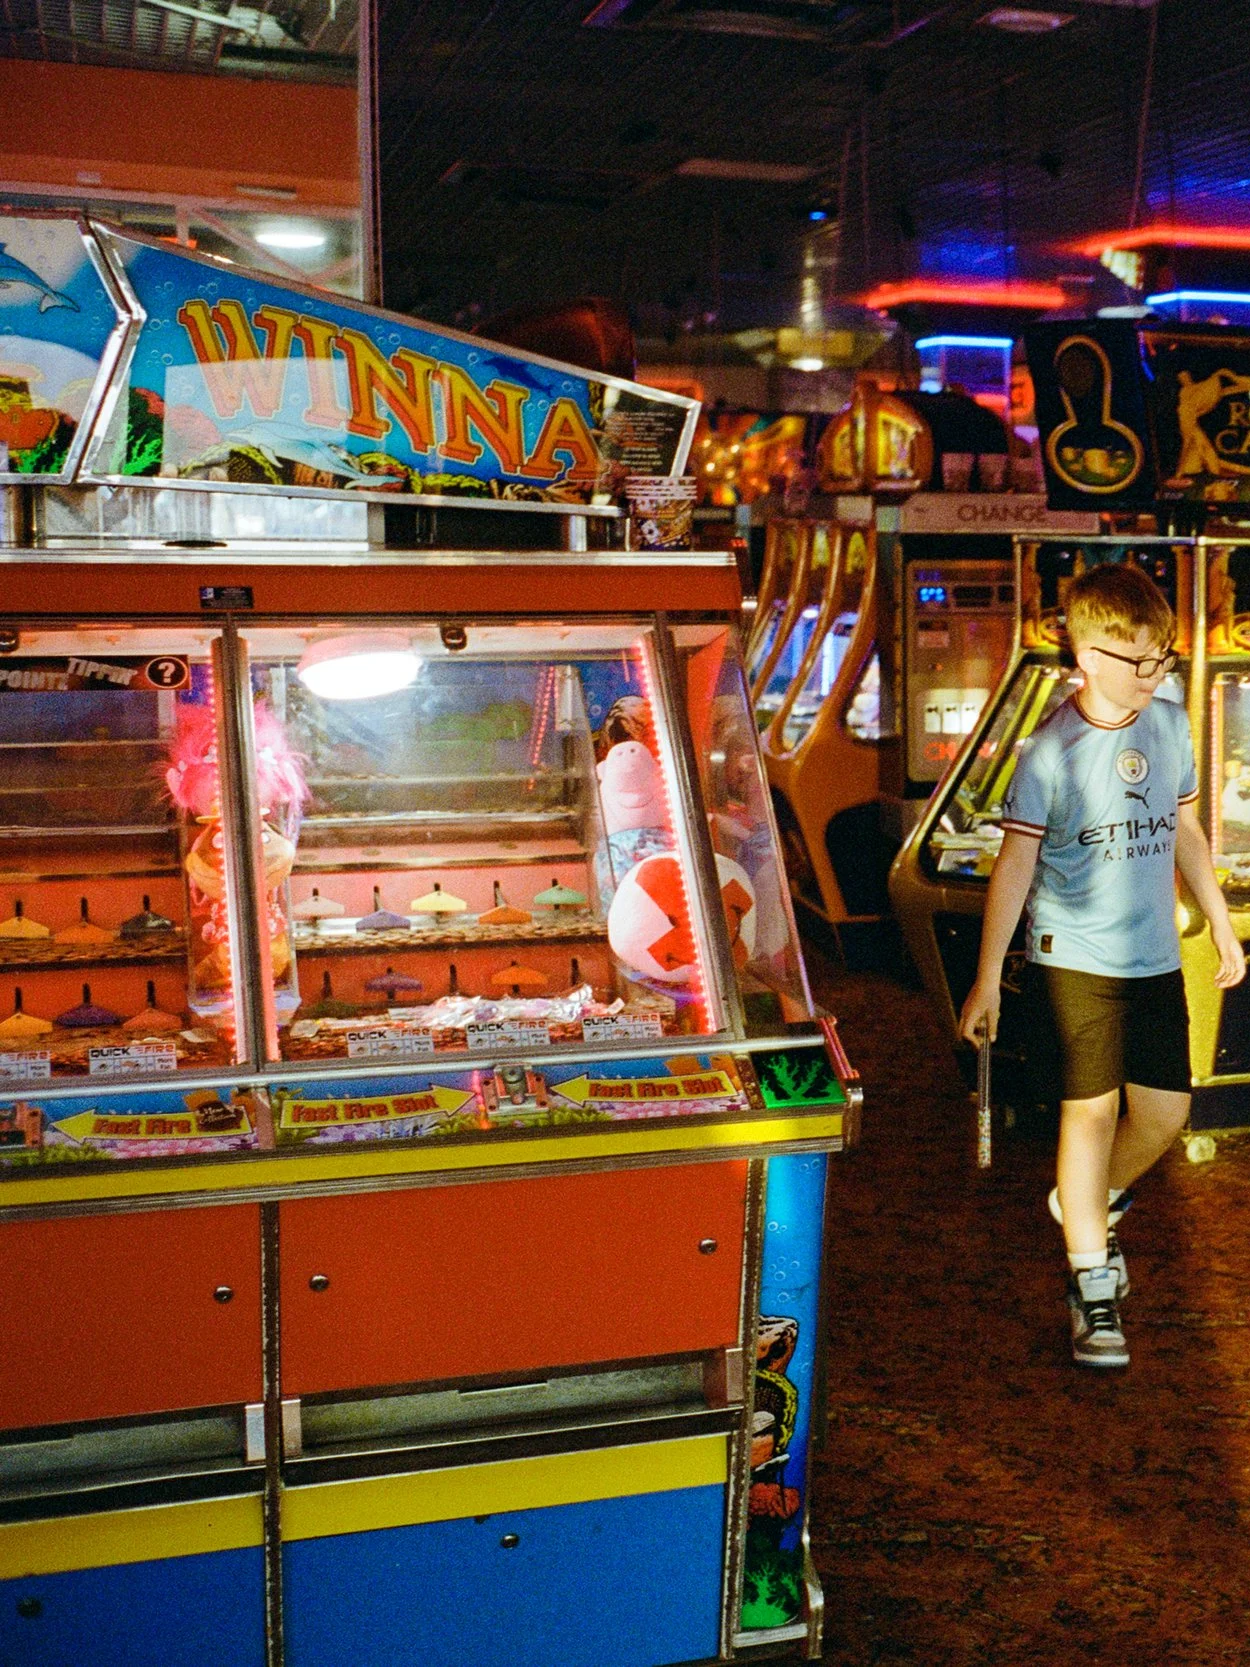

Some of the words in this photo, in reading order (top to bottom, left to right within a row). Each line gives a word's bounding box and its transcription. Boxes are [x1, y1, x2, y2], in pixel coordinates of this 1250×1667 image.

[178, 300, 609, 482] WINNA
[957, 504, 1047, 523] CHANGE
[467, 1022, 505, 1033] QUICK
[583, 1016, 619, 1026] QUICK
[348, 1031, 388, 1042] QUICK
[90, 1047, 131, 1058] QUICK
[588, 1083, 634, 1098] Fast
[637, 1081, 681, 1097] Fire
[291, 1103, 339, 1123] Fast
[343, 1101, 390, 1120] Fire
[92, 1118, 141, 1136] Fast
[145, 1117, 192, 1136] Fire
